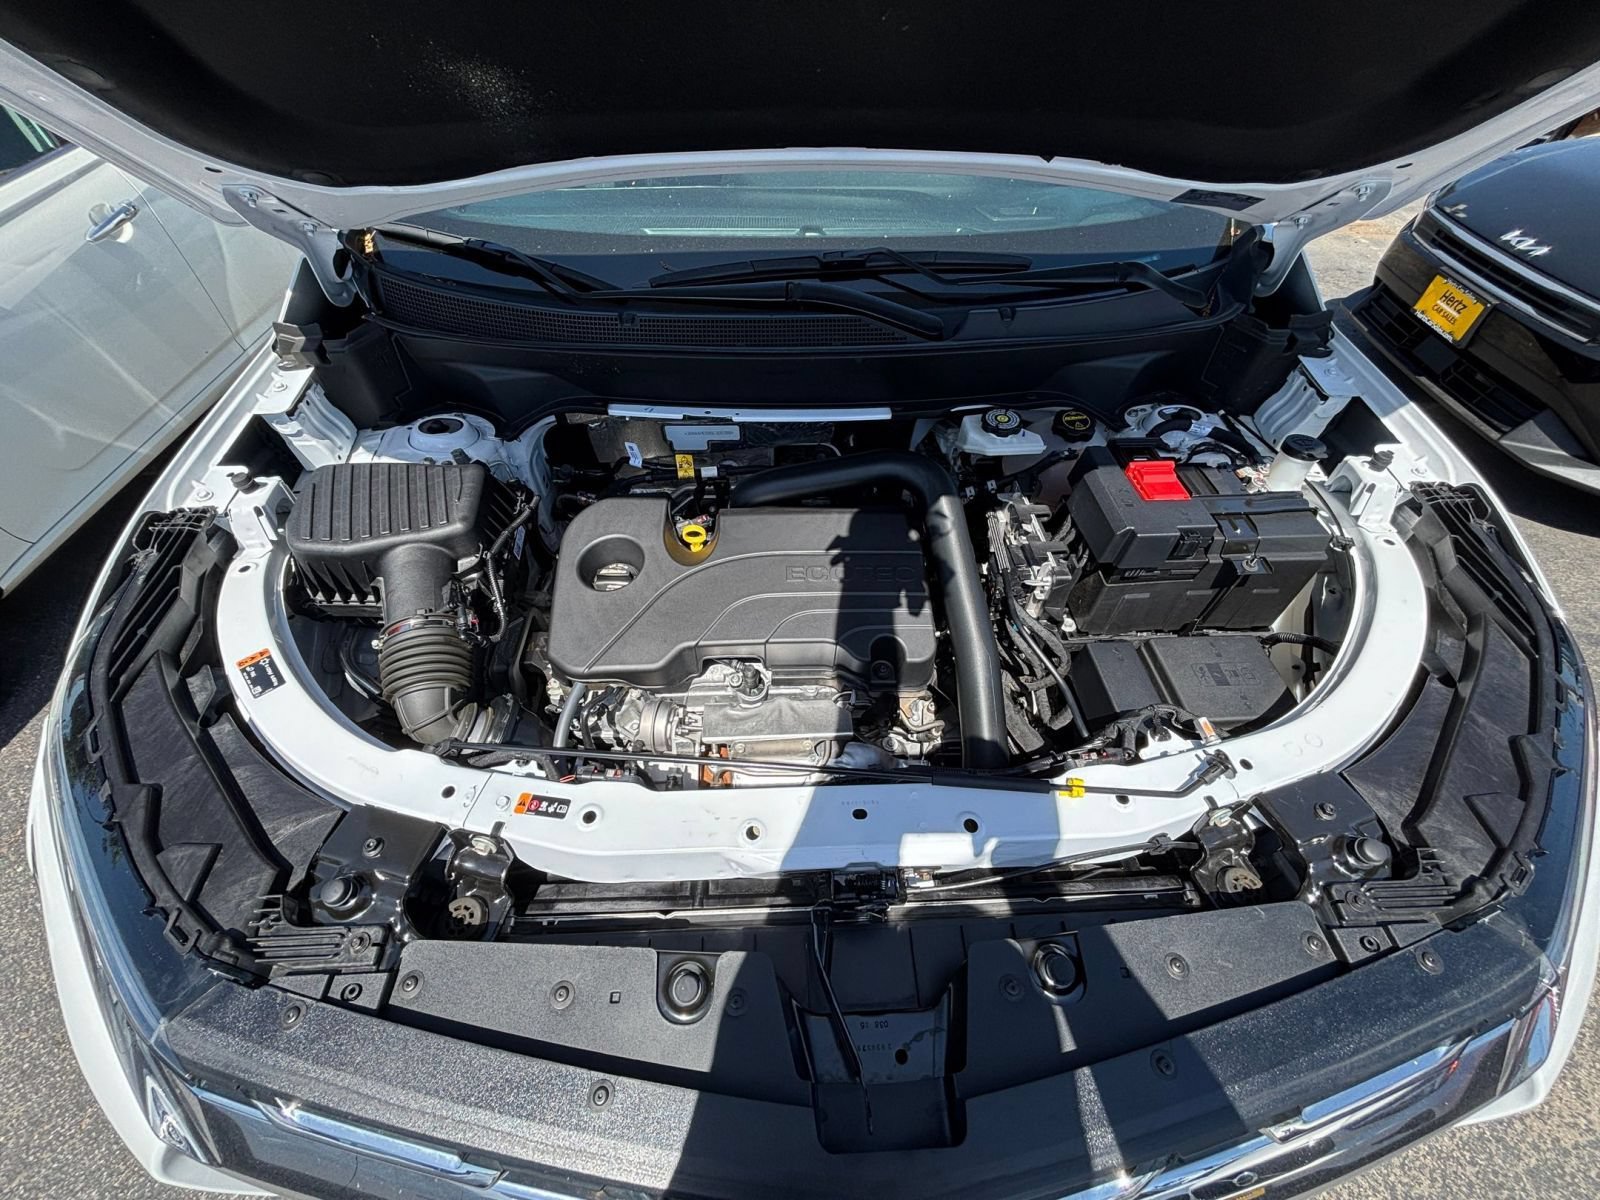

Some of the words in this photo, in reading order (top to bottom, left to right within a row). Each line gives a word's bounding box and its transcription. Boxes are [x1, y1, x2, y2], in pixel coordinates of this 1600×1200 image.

[1439, 289, 1467, 314] Hertz
[1431, 303, 1443, 315] CAR
[1440, 310, 1457, 325] SALES
[785, 565, 917, 582] ECOTEC
